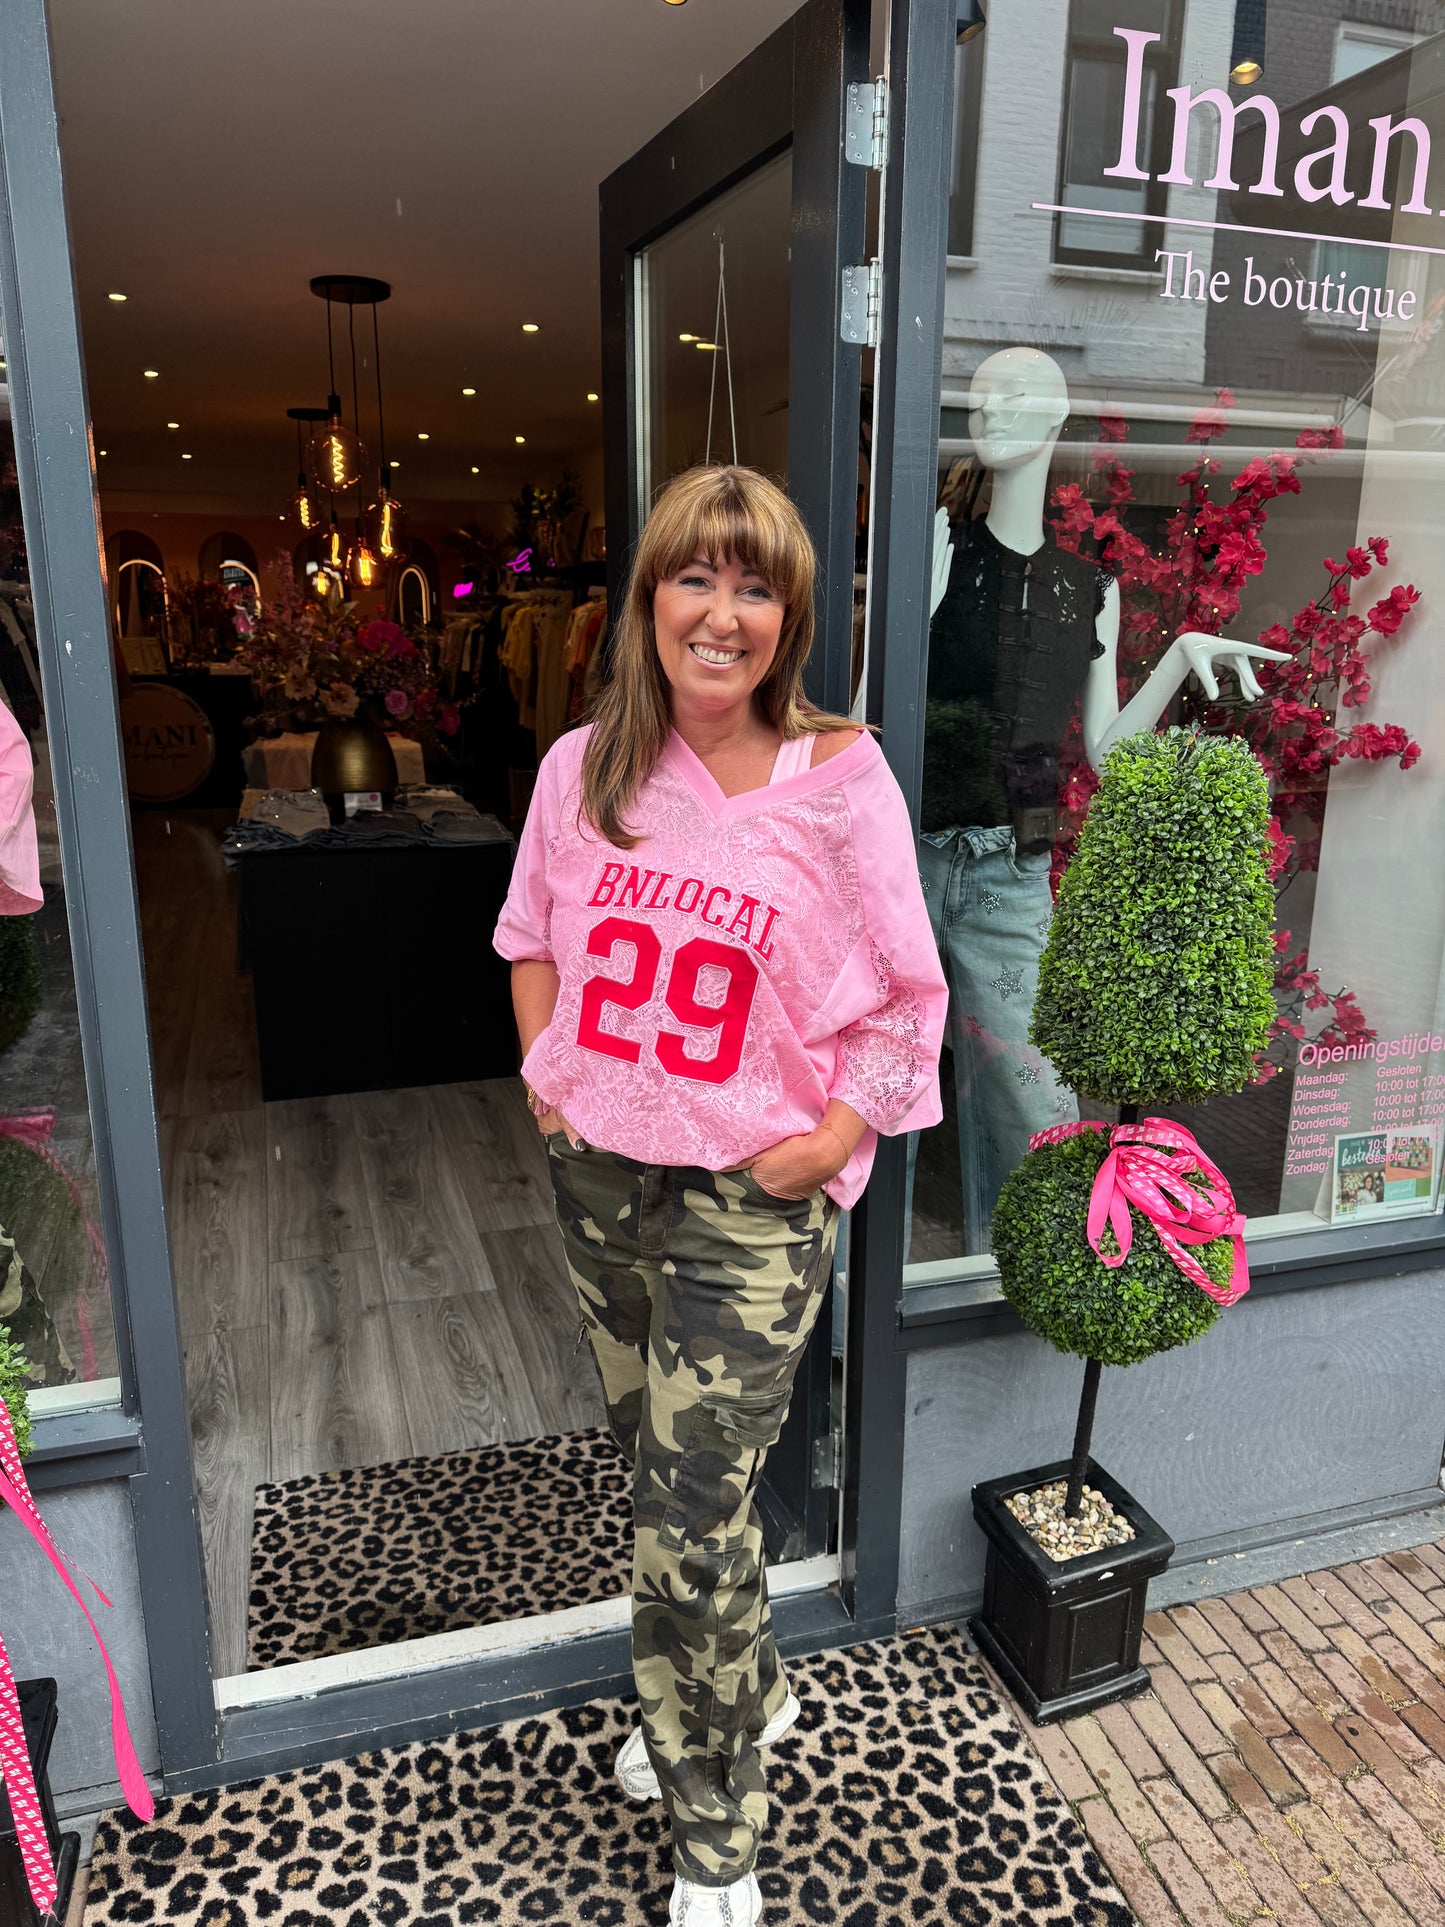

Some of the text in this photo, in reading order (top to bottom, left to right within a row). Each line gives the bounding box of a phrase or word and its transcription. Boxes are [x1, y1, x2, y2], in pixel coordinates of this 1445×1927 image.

[1103, 27, 1445, 216] Iman
[1154, 250, 1416, 331] The boutique
[127, 725, 196, 746] MANI
[576, 916, 760, 1086] 29
[1299, 1032, 1445, 1069] Openingstijde
[1296, 1065, 1422, 1086] Maandag: Gesloten
[1293, 1089, 1445, 1116] Woensdag: 10:00 tot 17:00
[1294, 1088, 1341, 1101] Dinsdag:
[1375, 1079, 1403, 1092] 10:00
[1405, 1078, 1419, 1089] tot
[1291, 1103, 1445, 1131] Donderdag: 10:00 tot 17:00
[1289, 1132, 1329, 1147] Vrijdag:
[1370, 1122, 1397, 1135] 10:00
[1368, 1137, 1395, 1150] 10:00
[1398, 1136, 1411, 1147] tot
[1285, 1151, 1410, 1176] Zondag: Gesloten
